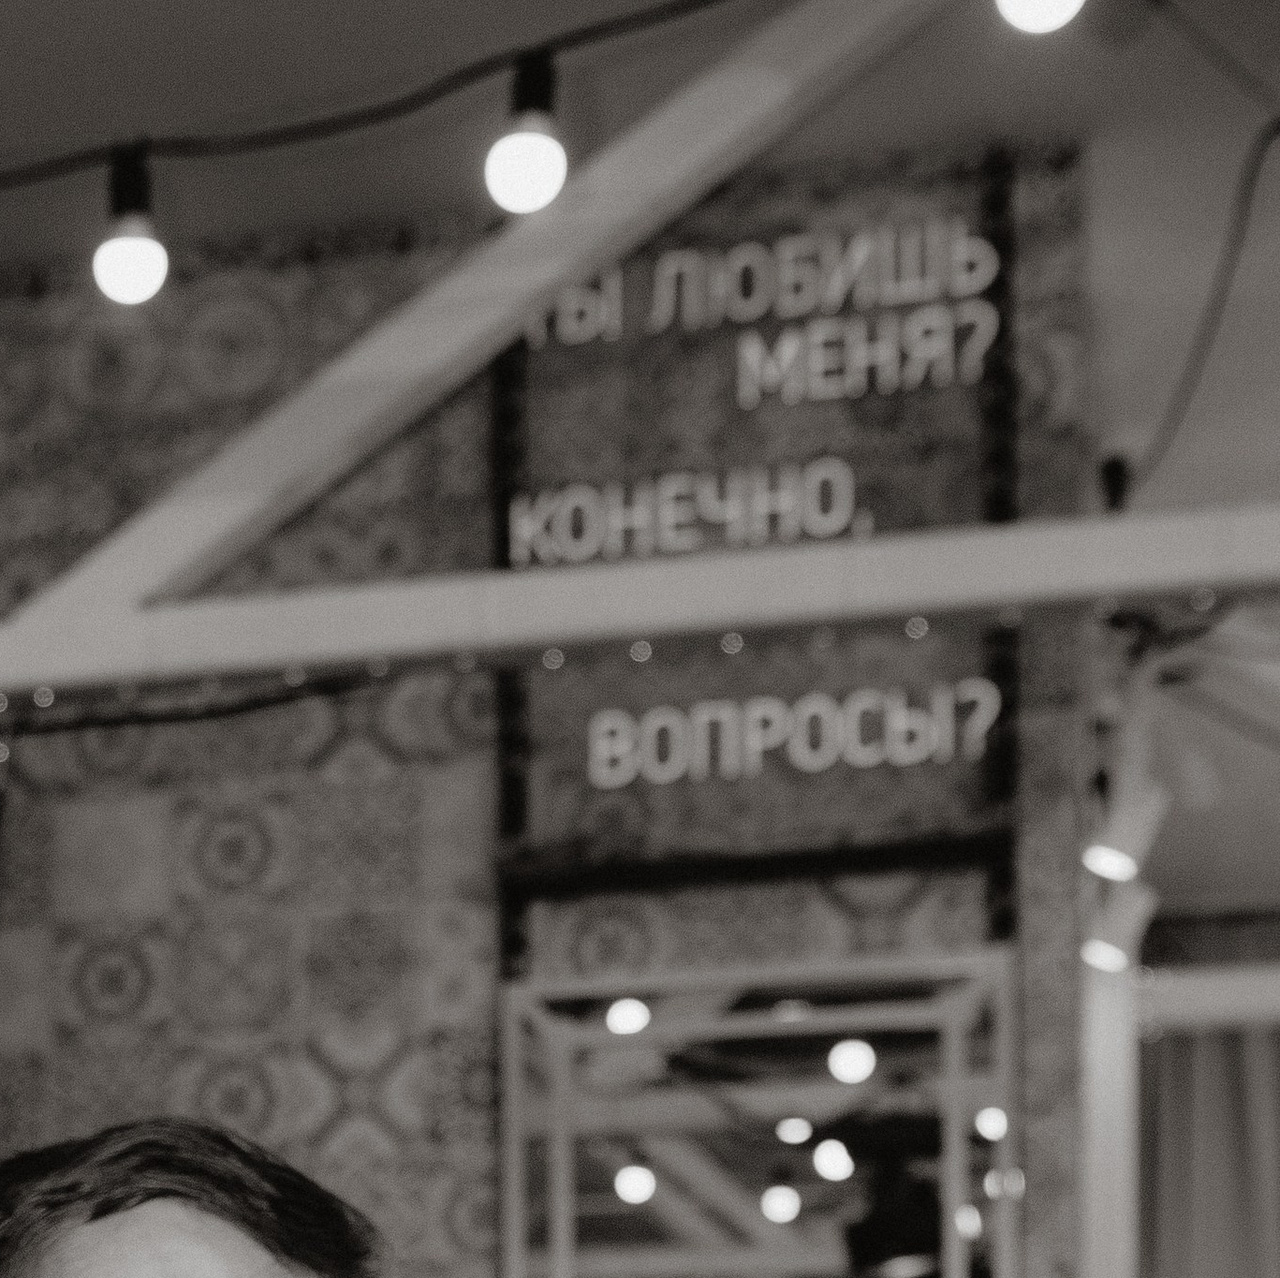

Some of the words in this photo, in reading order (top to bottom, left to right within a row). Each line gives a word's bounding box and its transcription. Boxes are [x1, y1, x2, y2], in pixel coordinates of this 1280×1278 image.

[647, 220, 1000, 333] ЛЮБИШЬ
[738, 299, 1000, 410] МЕНЯ?
[588, 675, 1002, 789] ВОПРОСЫ?
